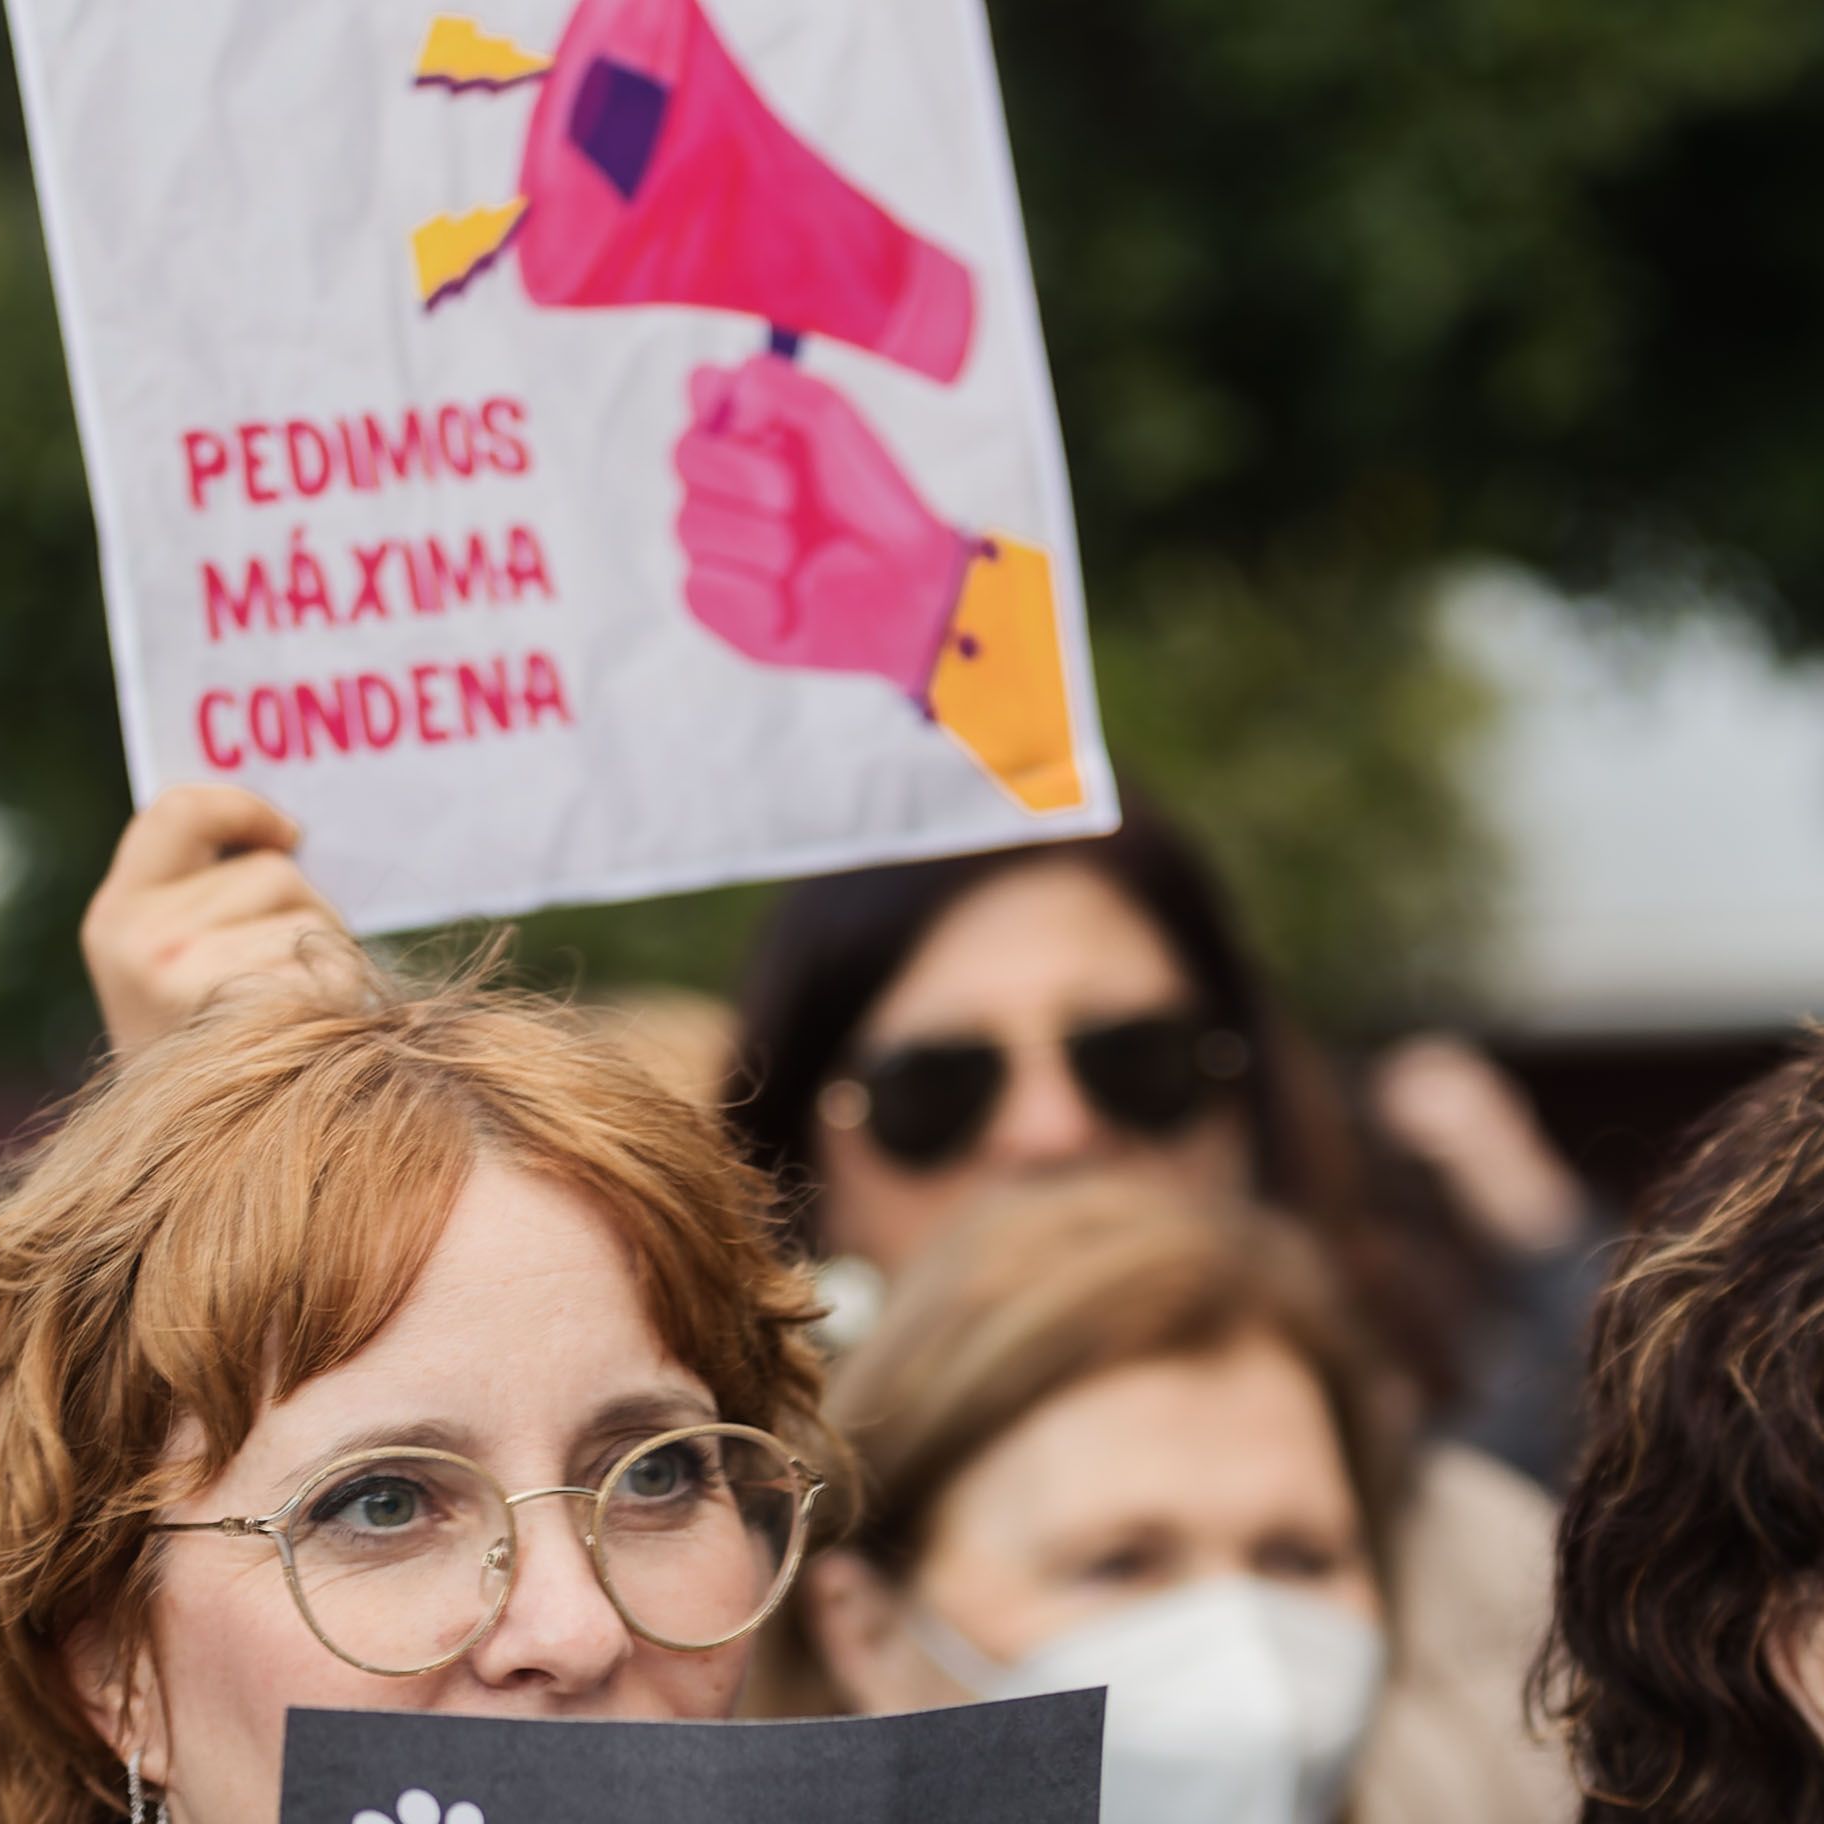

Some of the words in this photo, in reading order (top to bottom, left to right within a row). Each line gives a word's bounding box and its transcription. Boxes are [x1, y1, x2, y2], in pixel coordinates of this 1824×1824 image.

[183, 396, 531, 508] PEDIMOS
[201, 526, 553, 642] MÁXIMA
[197, 651, 568, 770] CONDENA
